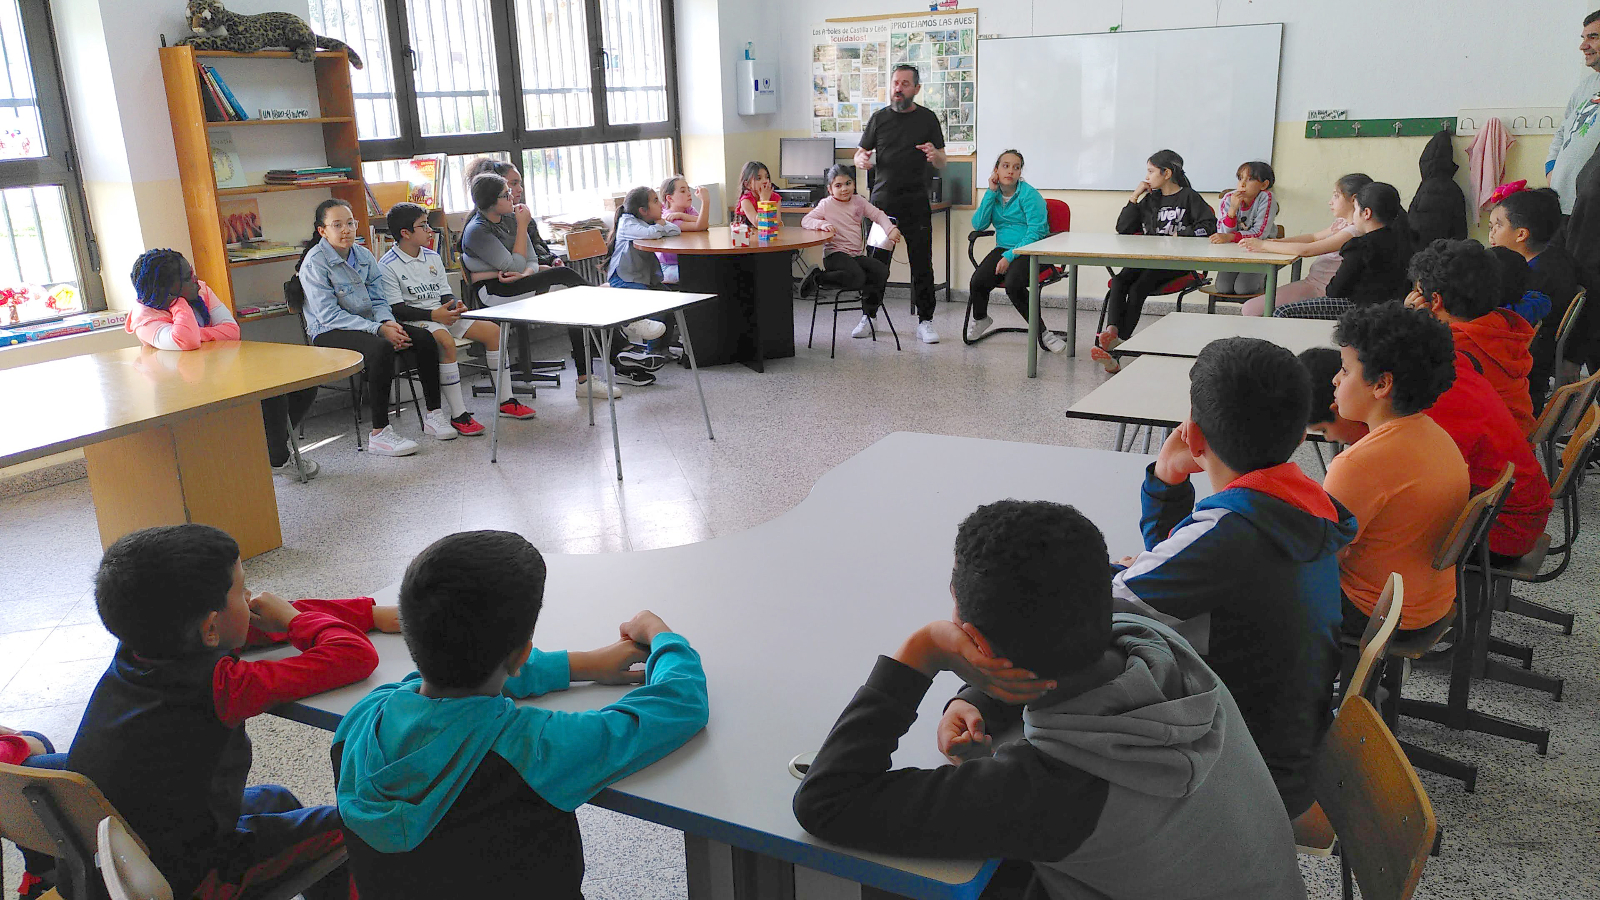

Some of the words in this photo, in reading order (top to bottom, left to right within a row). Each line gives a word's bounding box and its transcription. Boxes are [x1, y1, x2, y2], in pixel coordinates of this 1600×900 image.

[938, 18, 953, 27] LAS
[849, 26, 869, 34] Castilla
[874, 24, 888, 33] León
[407, 282, 440, 295] Emirates
